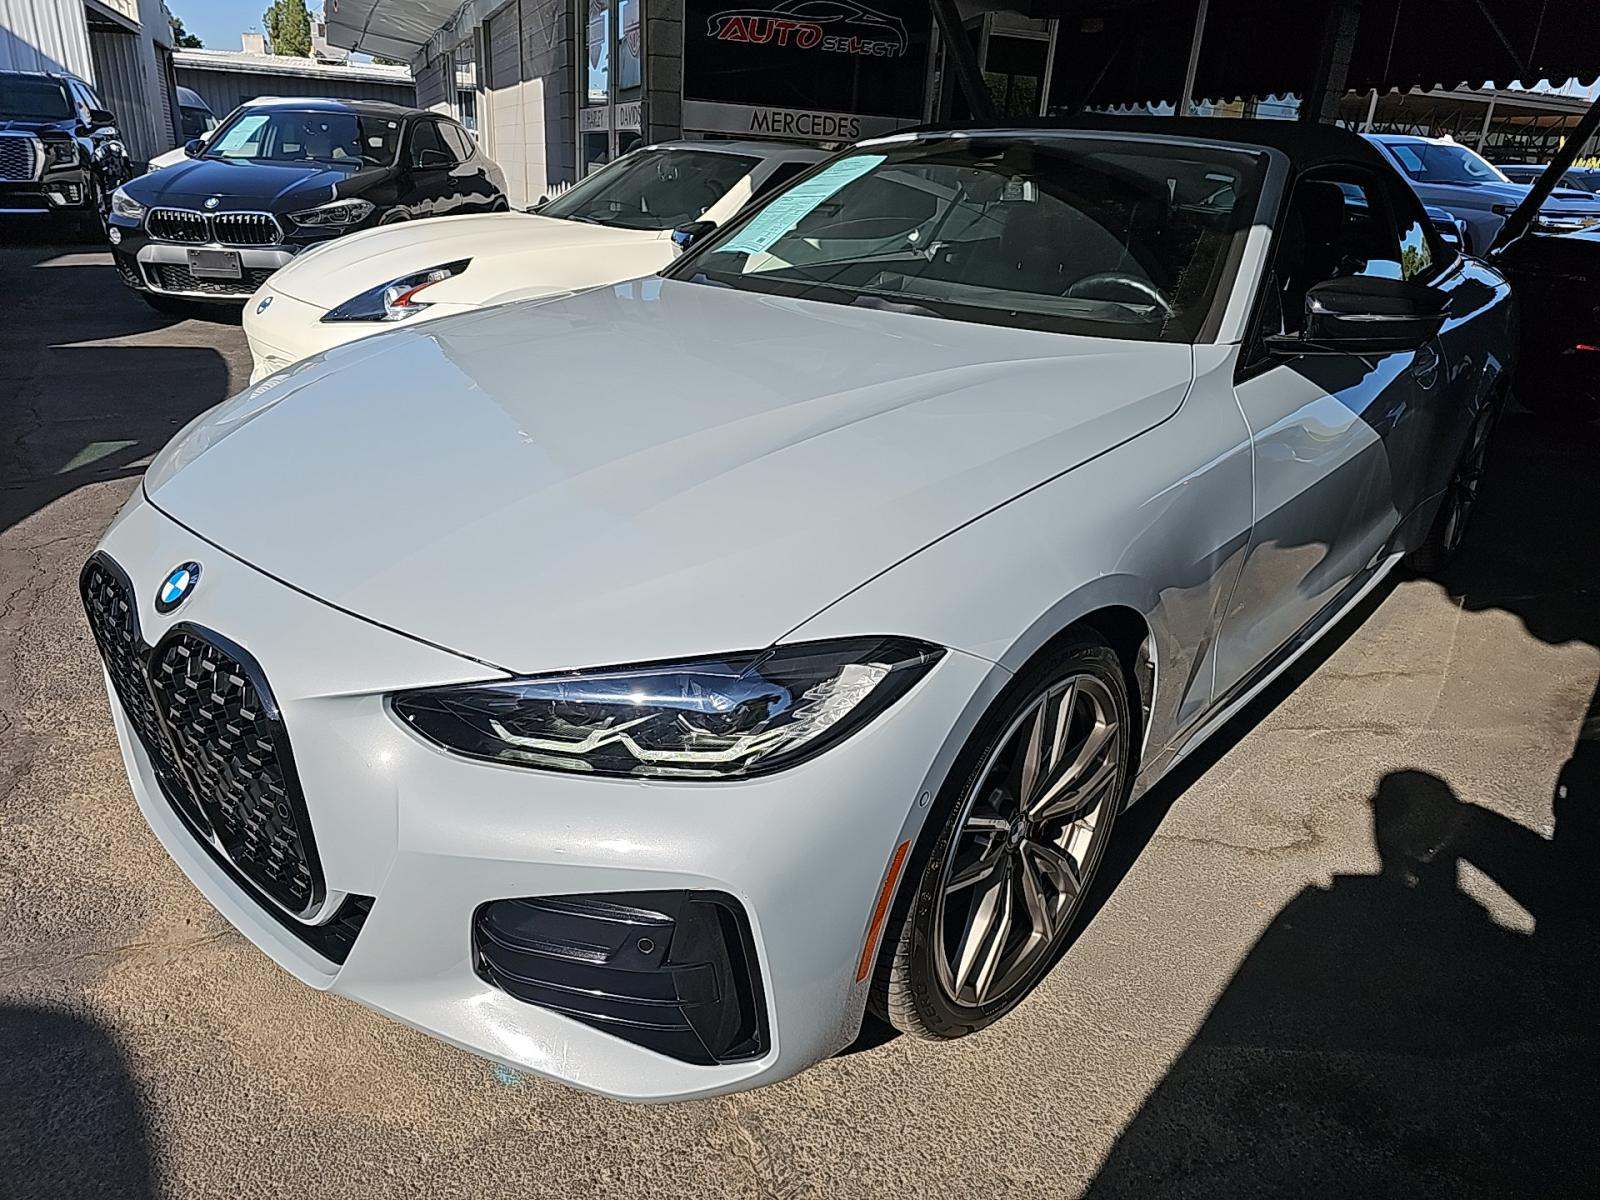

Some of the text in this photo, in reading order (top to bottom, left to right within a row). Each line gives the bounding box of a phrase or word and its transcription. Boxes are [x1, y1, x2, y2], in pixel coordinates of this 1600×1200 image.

[718, 16, 900, 57] AUTO SELECT
[749, 109, 860, 138] MERCEDES
